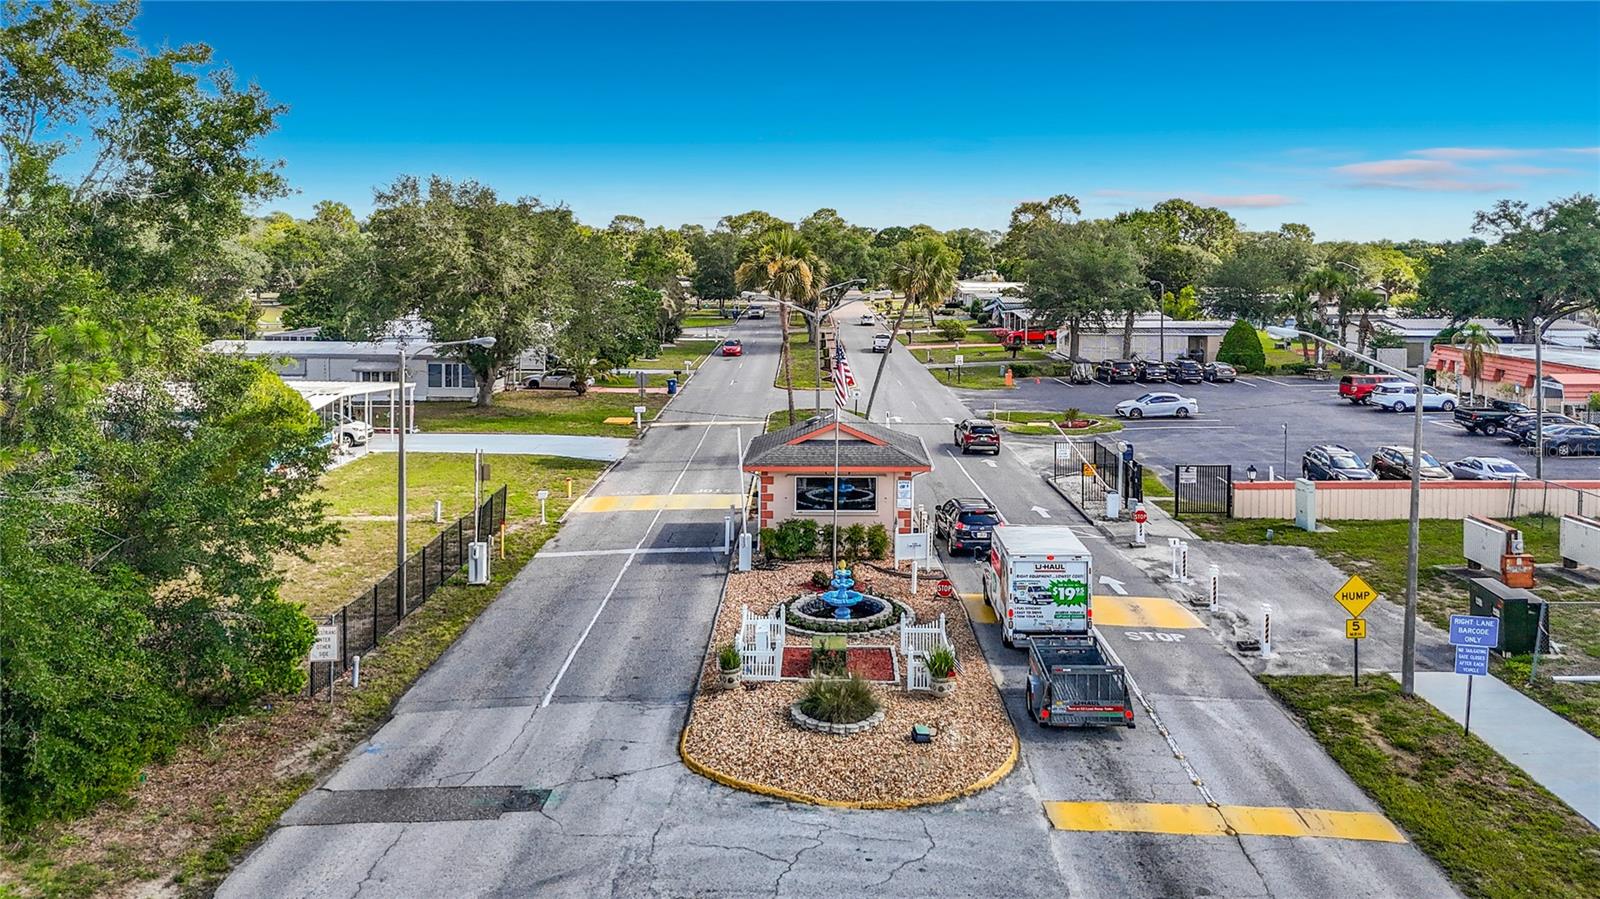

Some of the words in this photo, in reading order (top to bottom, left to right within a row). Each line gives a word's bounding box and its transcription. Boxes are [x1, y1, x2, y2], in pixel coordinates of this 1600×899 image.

[1342, 591, 1370, 600] HUMP
[1352, 621, 1360, 631] 5
[1458, 627, 1489, 635] BARCODE
[1125, 632, 1186, 642] STOP
